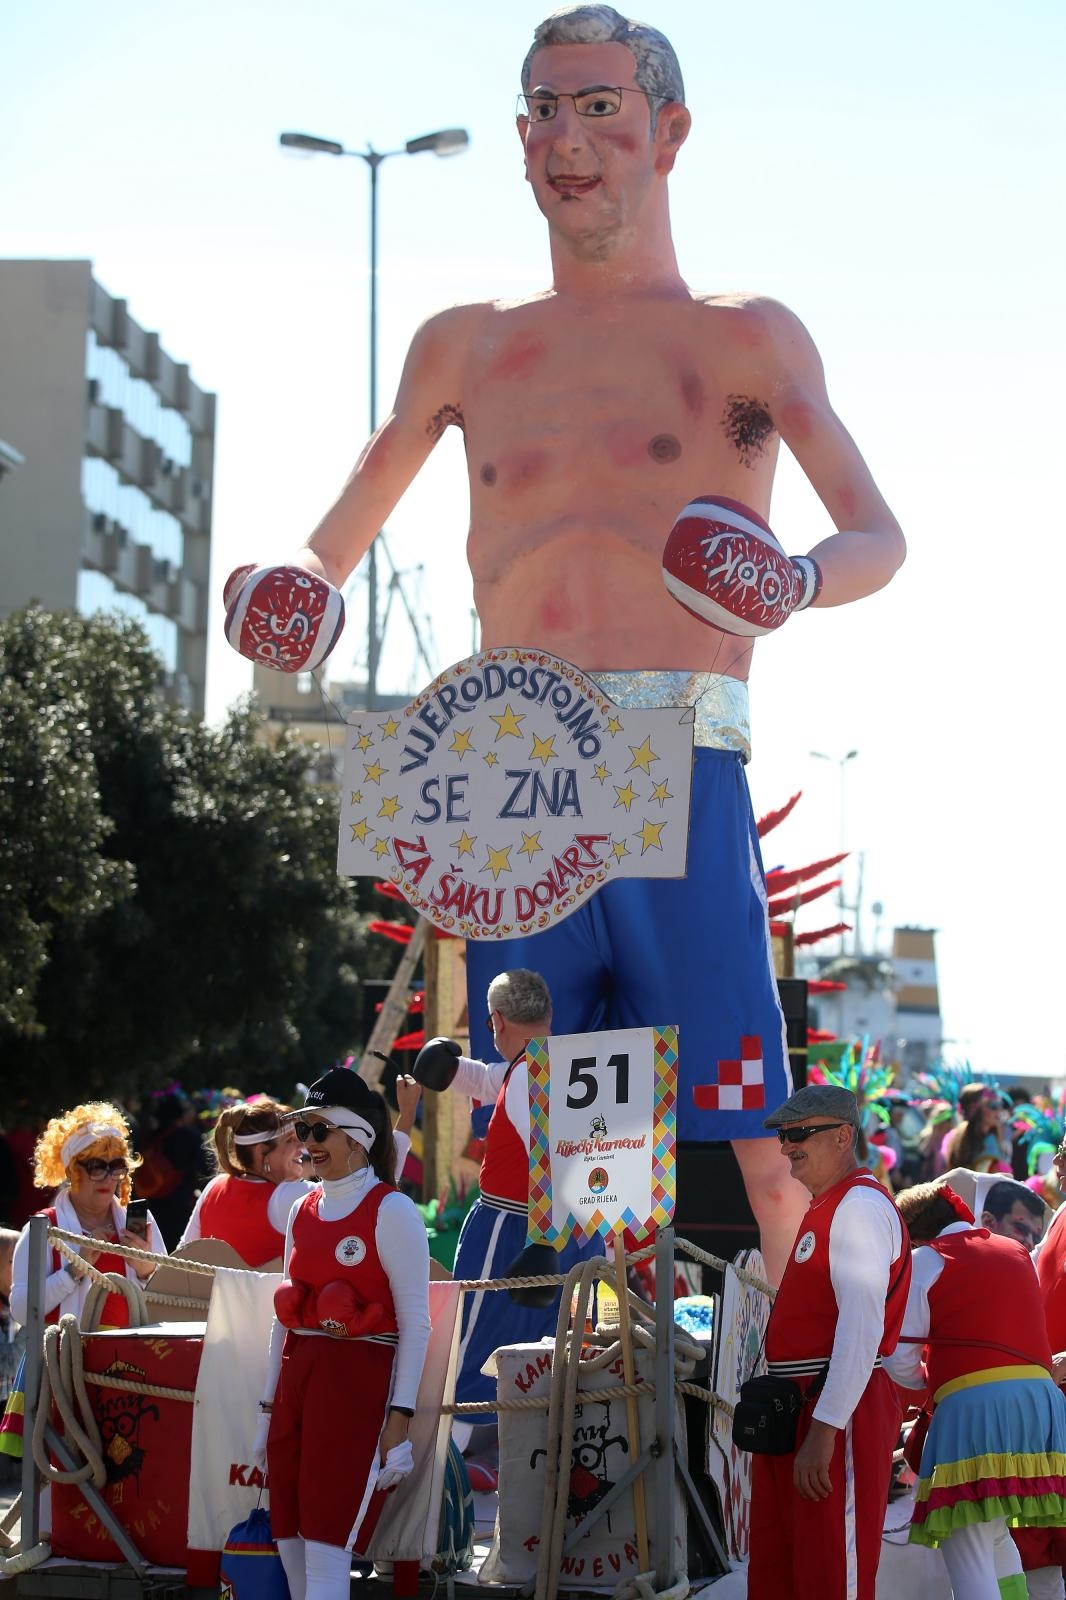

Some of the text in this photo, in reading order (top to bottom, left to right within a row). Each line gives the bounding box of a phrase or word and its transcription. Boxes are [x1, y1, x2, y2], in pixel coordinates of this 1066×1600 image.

[399, 664, 601, 776] VJERODOSTOJNO
[411, 768, 583, 824] SE ZNA
[392, 833, 611, 925] ZA ŠAKU DOLARA
[566, 1053, 629, 1109] 51
[579, 1195, 618, 1205] GRAD RIJEKA
